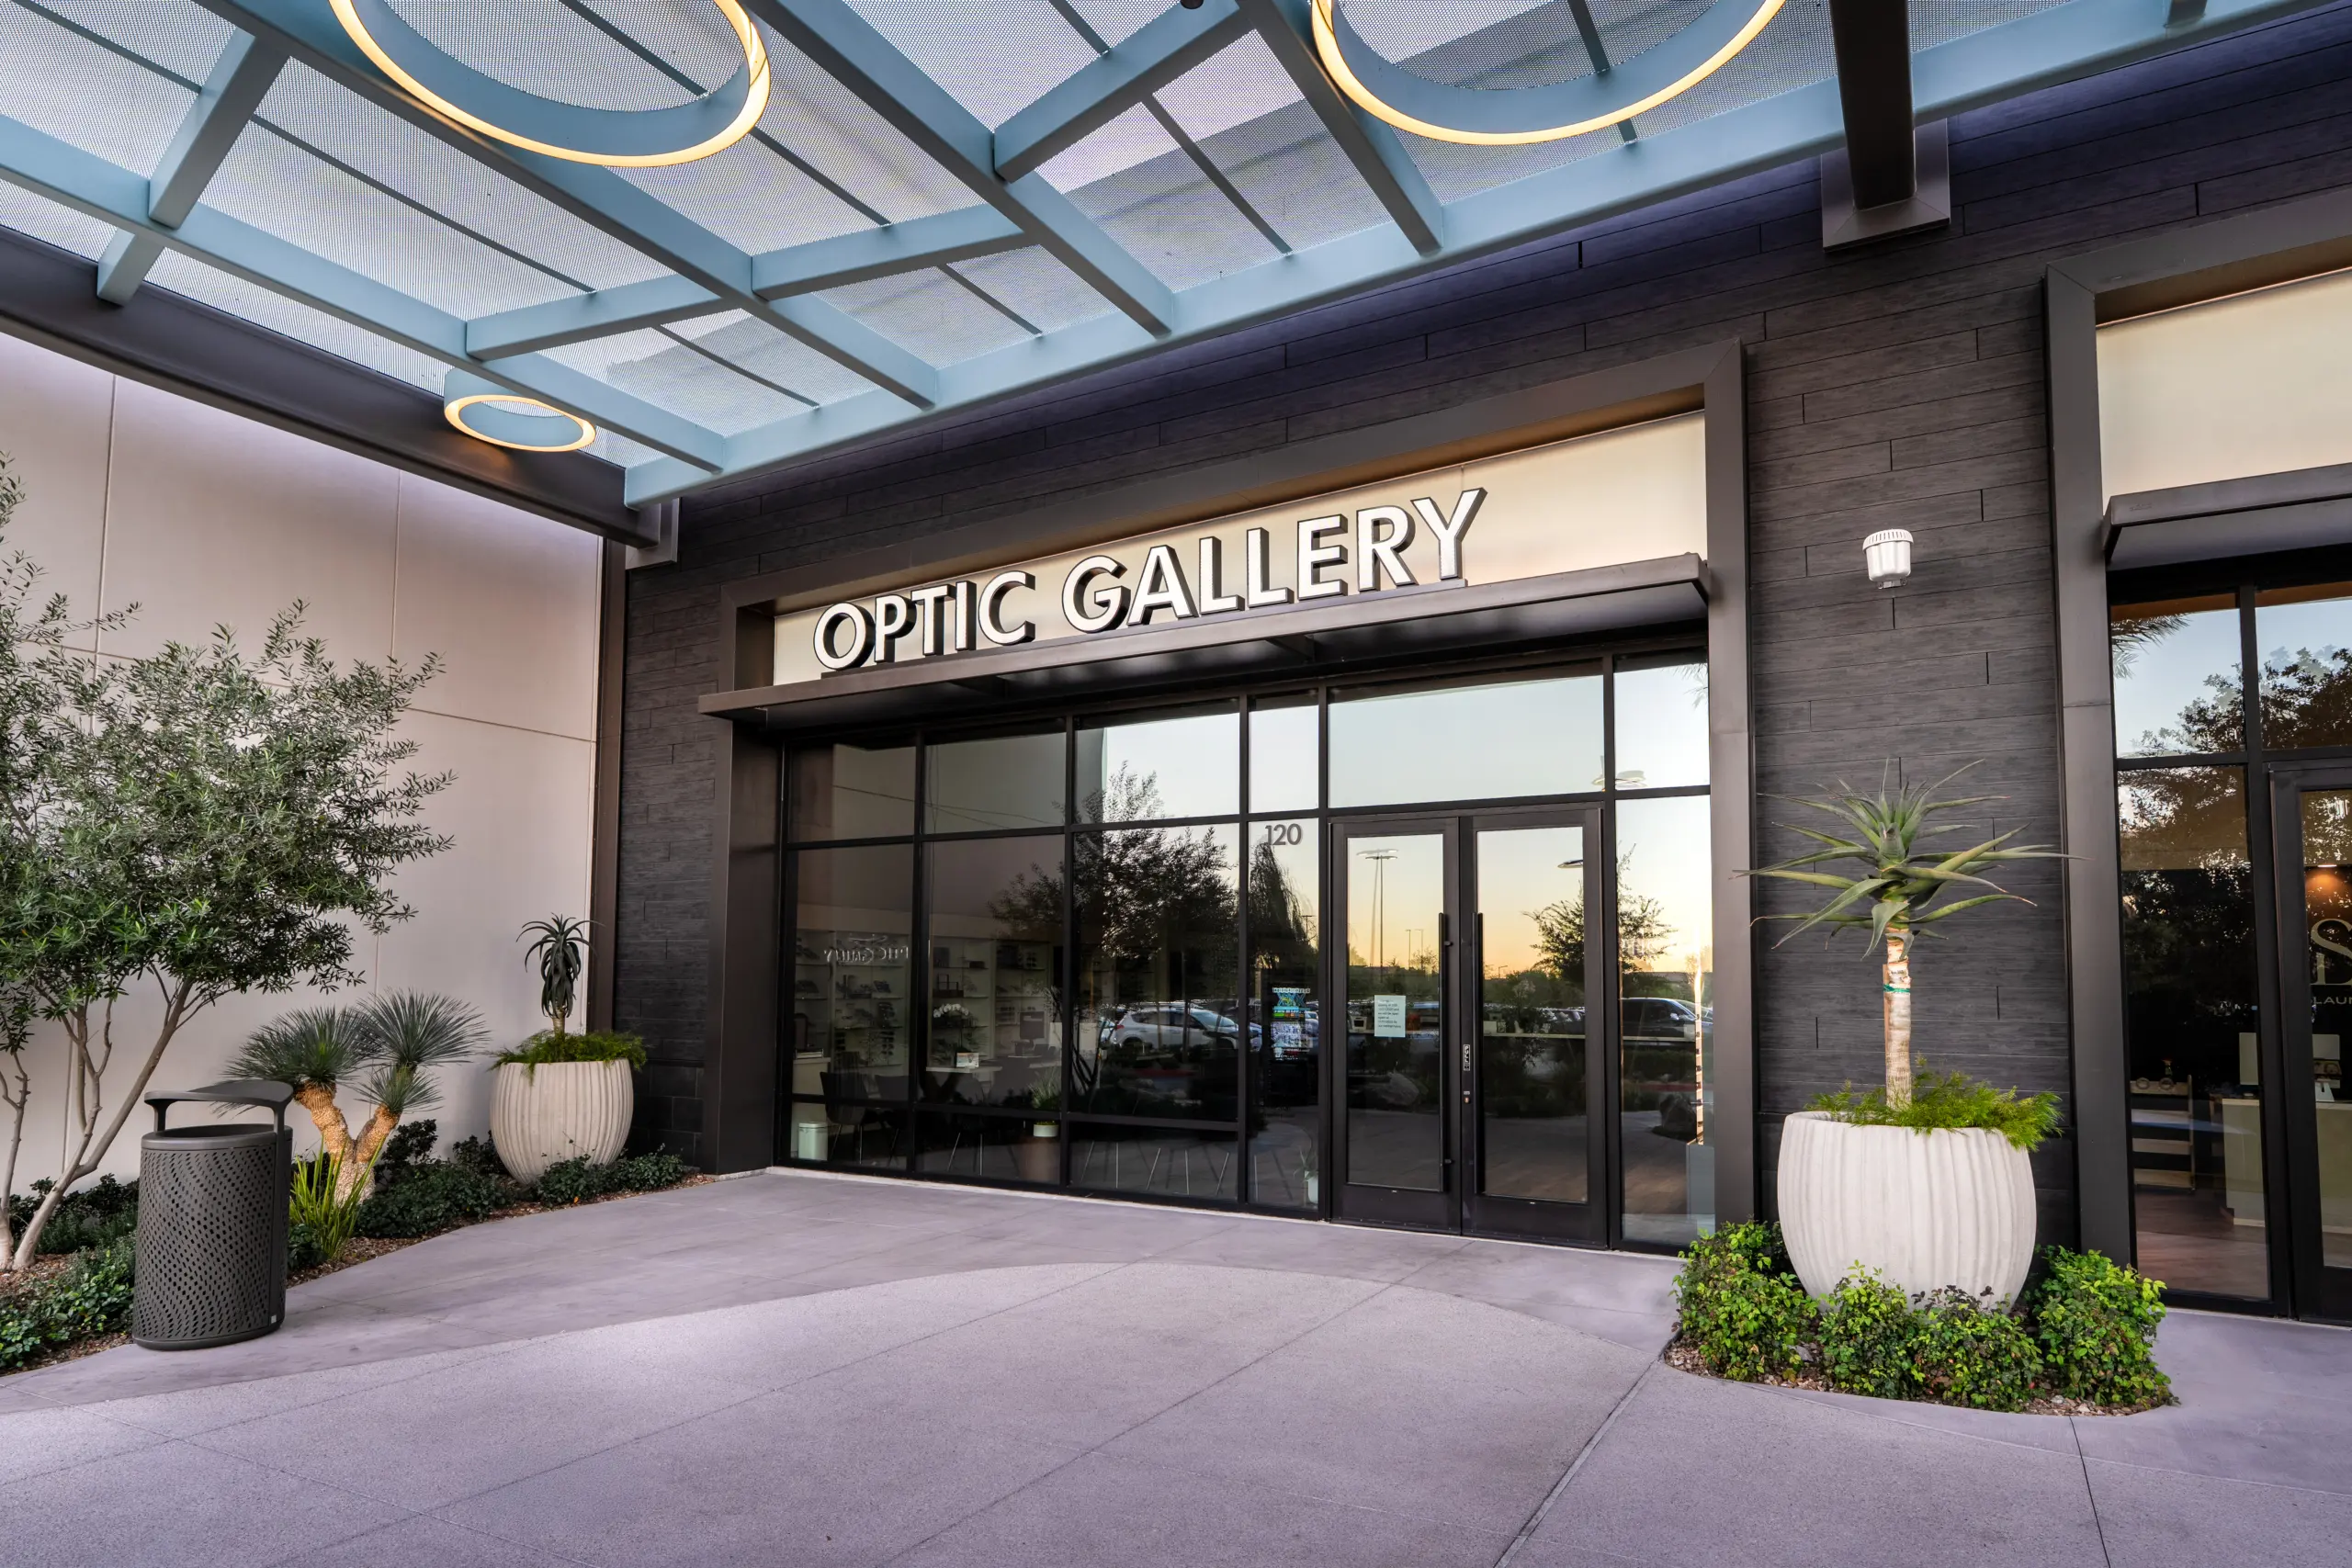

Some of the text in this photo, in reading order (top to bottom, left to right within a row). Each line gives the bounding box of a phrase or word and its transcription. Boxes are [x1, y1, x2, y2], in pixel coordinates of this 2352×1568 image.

[813, 487, 1487, 671] OPTIC GALLERY
[1265, 823, 1303, 846] 120
